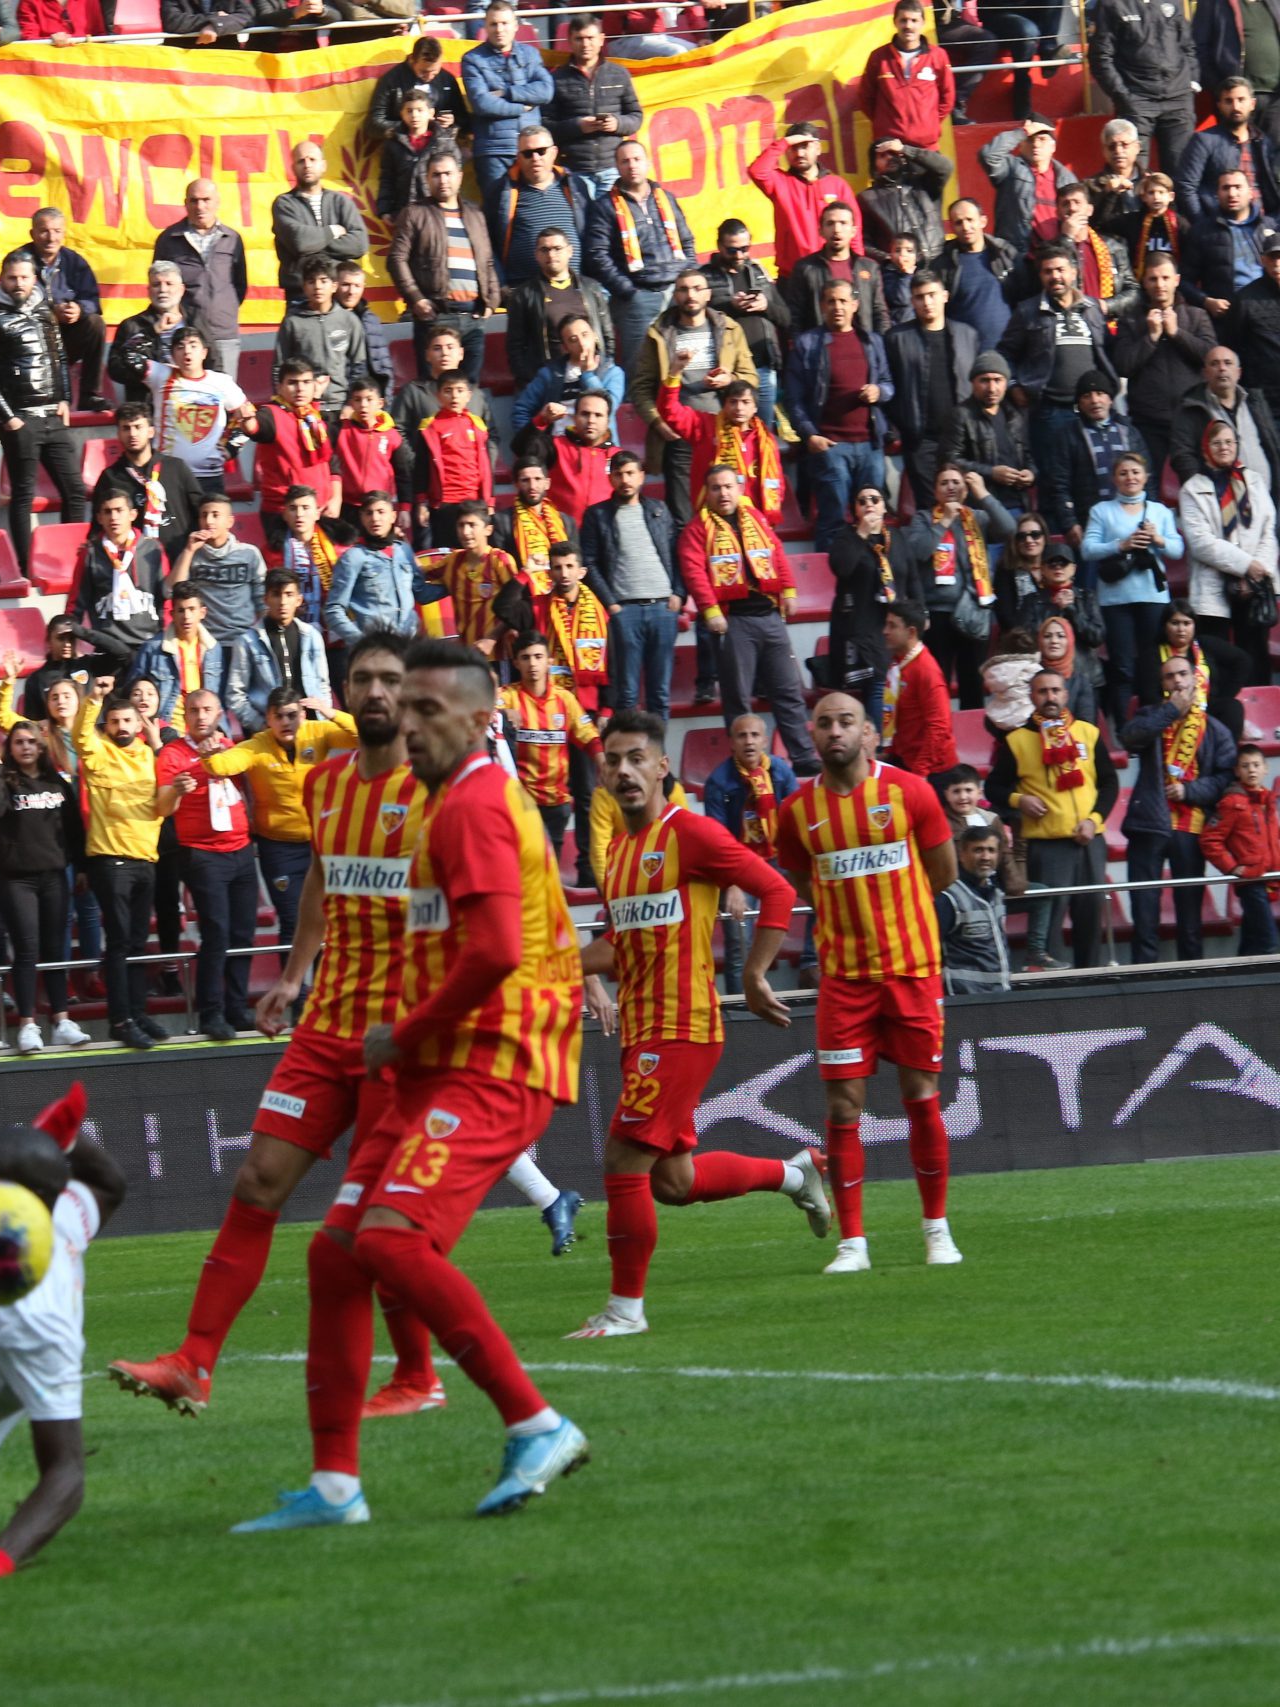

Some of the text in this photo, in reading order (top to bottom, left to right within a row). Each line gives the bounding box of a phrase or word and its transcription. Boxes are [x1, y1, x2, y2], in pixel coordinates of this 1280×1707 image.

[327, 861, 409, 889] istikba
[832, 843, 906, 875] istikbal
[267, 1095, 304, 1115] KABLO
[620, 1071, 661, 1116] 32
[394, 1132, 451, 1188] 13
